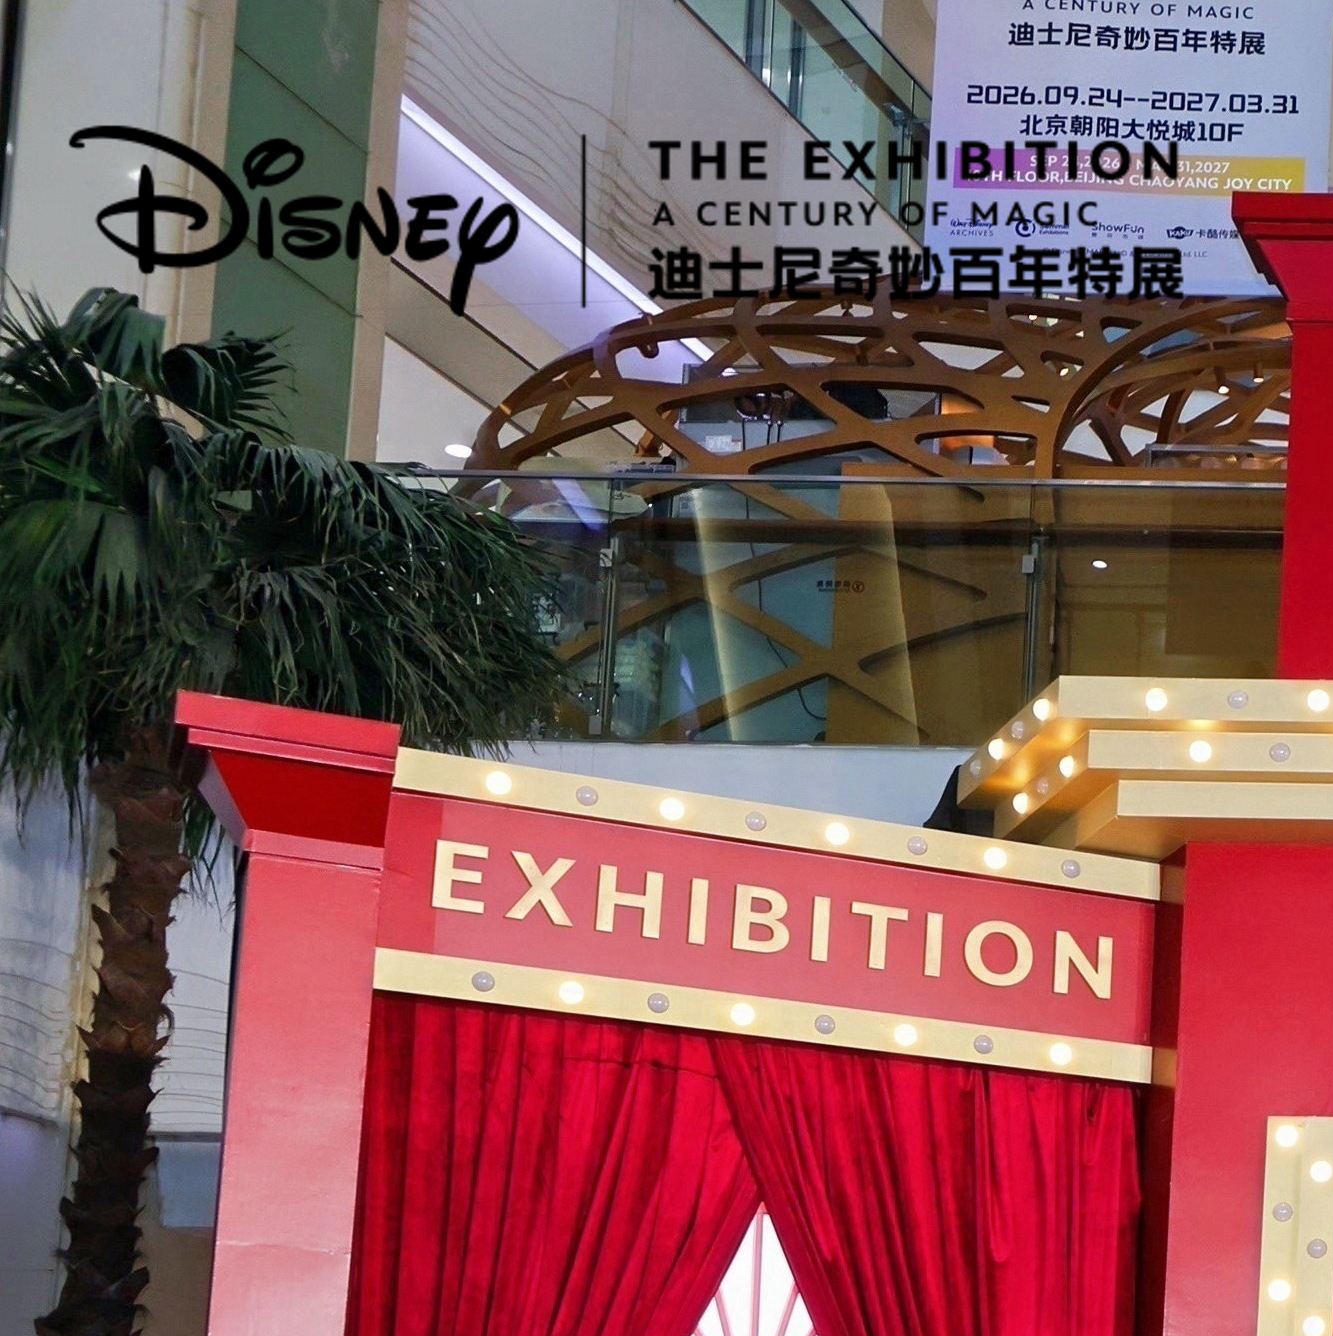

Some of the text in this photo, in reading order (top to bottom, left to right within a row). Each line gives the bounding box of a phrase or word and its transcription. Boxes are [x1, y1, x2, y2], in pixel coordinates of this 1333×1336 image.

[1045, 0, 1140, 14] CENTURY
[1150, 3, 1177, 16] OF
[1187, 5, 1254, 19] MAGIC
[1008, 22, 1265, 55] 迪士尼奇妙百年特展
[1019, 114, 1244, 142] 北京朝阳大悦城10F
[1030, 155, 1057, 168] SP
[1129, 174, 1218, 189] CHAOYANG
[1223, 178, 1252, 190] JOY
[1257, 178, 1293, 190] CITY
[430, 838, 1115, 1000] EXHIBITION
